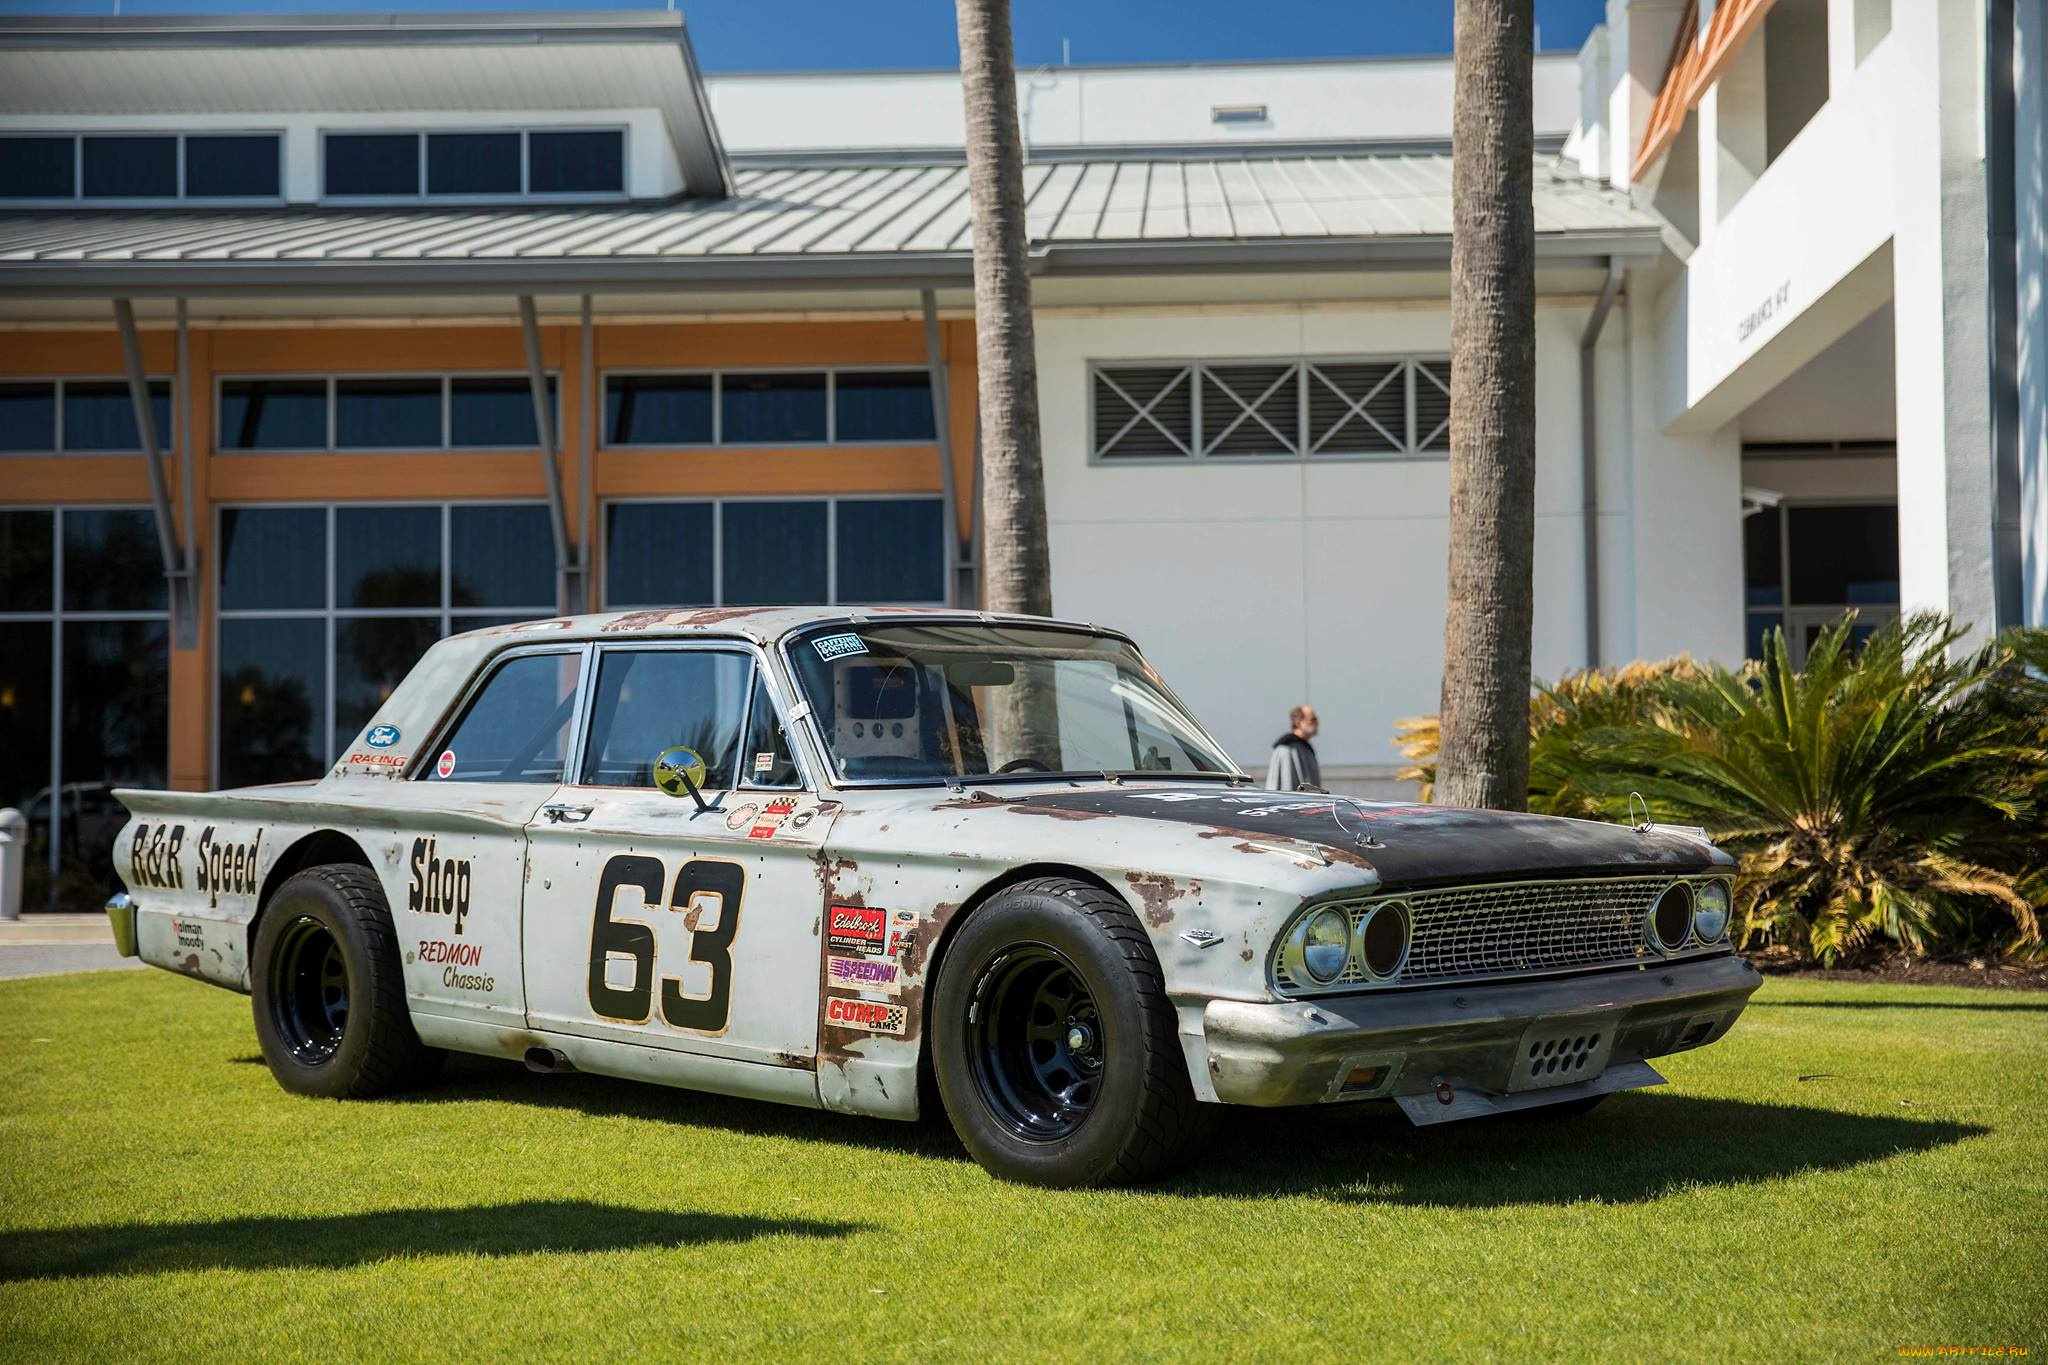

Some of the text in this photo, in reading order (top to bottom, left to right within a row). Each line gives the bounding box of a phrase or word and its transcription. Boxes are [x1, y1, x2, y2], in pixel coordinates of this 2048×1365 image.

[817, 636, 857, 648] CAFFEINE
[370, 727, 396, 744] Ford
[350, 753, 408, 767] RACING
[130, 823, 263, 909] R&R Speed
[408, 835, 471, 935] Shop
[171, 918, 203, 935] holman
[833, 913, 880, 932] Edelbrock
[178, 935, 204, 951] moody
[587, 852, 748, 1037] 63
[829, 936, 867, 946] CYLINDER
[855, 945, 882, 954] HEADS
[418, 940, 482, 967] REDMON
[443, 966, 495, 992] Chassis
[842, 960, 898, 983] SPEEDWAY
[829, 1000, 888, 1023] COMP
[868, 1020, 898, 1031] CAMS
